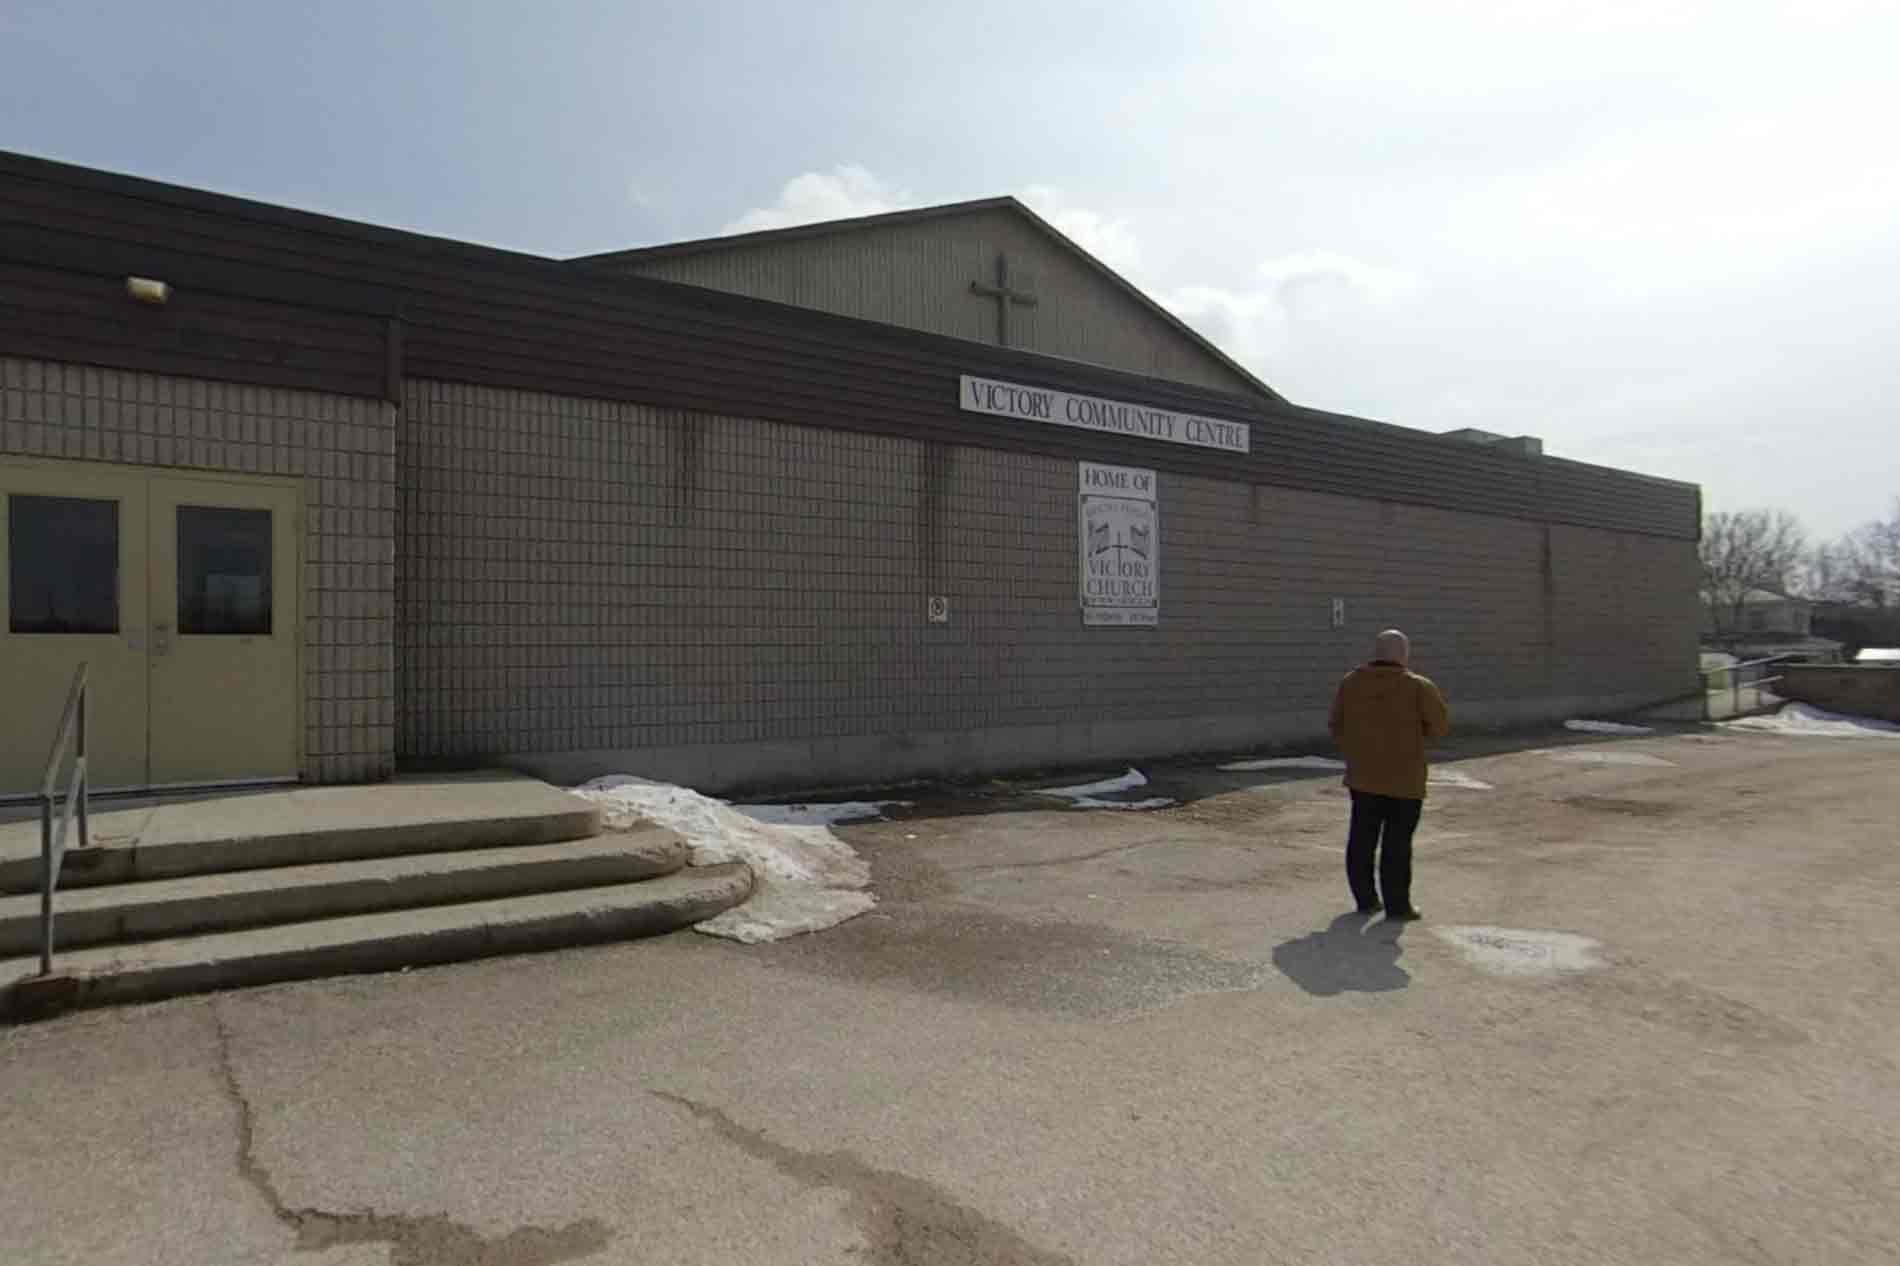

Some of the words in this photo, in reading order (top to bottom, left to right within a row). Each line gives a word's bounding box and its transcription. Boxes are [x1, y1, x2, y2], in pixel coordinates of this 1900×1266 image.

[969, 381, 1055, 418] VICTORY
[1066, 397, 1177, 439] COMMUNITY
[1185, 418, 1243, 448] CENTRE
[1085, 468, 1129, 489] HOME
[1133, 473, 1153, 491] OF
[1087, 558, 1150, 578] VICTORY
[1087, 579, 1153, 598] CHURCH
